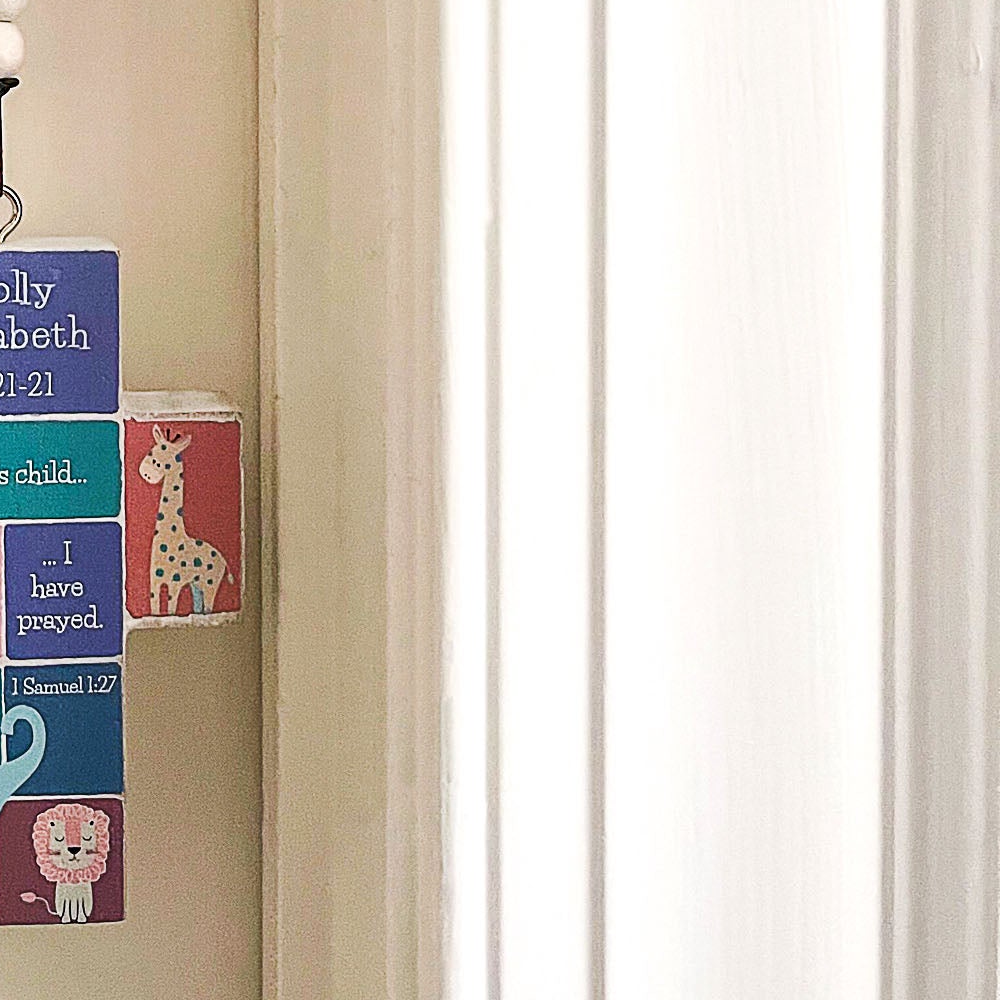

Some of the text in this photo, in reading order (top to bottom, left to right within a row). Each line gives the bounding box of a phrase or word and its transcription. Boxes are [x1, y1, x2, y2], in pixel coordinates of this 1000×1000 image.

[15, 459, 87, 486] child...
[63, 540, 73, 565] I
[29, 573, 84, 599] have
[16, 605, 104, 636] prayed.
[11, 675, 117, 696] 1 Samuel 1:27
